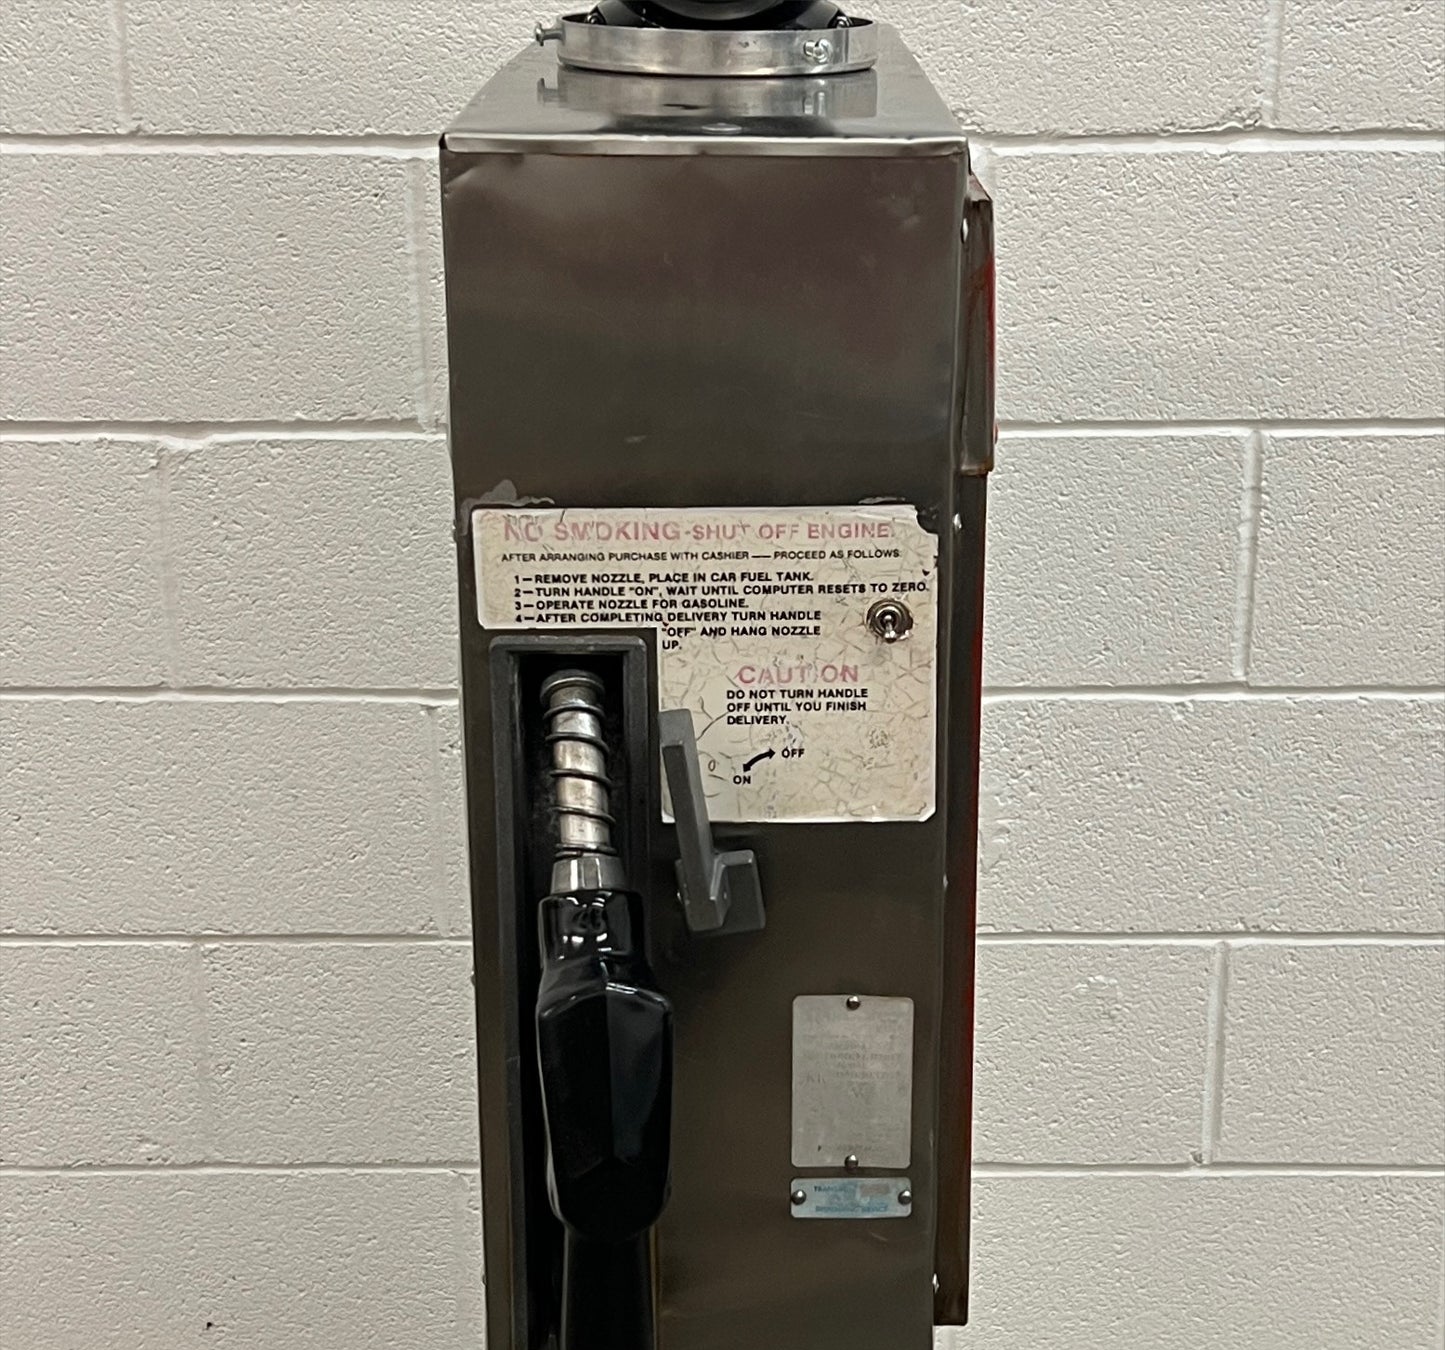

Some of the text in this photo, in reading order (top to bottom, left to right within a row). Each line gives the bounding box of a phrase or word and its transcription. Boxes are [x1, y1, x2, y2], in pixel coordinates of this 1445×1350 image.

[759, 523, 799, 539] OFF
[501, 553, 536, 562] AFTER
[539, 552, 605, 562] ARRANGING
[609, 551, 668, 561] PURCHASE
[670, 551, 698, 561] WITH
[702, 550, 750, 560] CASHIER
[773, 550, 826, 560] PROCEED
[830, 549, 844, 559] AS
[649, 572, 690, 583] PLACE
[693, 572, 707, 583] IN
[711, 571, 736, 582] CAR
[740, 571, 772, 582] FUEL
[776, 571, 815, 581] TANK.
[574, 586, 626, 597] HANDLE
[666, 586, 699, 596] WAIT
[702, 585, 739, 595] UNTIL
[743, 584, 814, 595] COMPUTER
[818, 583, 866, 594] RESETS
[870, 582, 888, 593] TO
[599, 599, 649, 609] NOZZLE
[652, 599, 678, 609] FOR
[682, 598, 750, 609] GASOLINE.
[580, 612, 664, 623] COMPLETING
[667, 612, 728, 622] DELIVERY
[731, 611, 767, 621] TURN
[770, 610, 822, 621] HANDLE
[661, 625, 821, 638] "OFF" AND HANG NOZZLE
[662, 640, 683, 650] UP.
[726, 688, 869, 699] DO NOT TURN HANDLE
[726, 701, 867, 712] OFF UNTIL YOU FINISH
[726, 715, 790, 725] DELIVERY.
[781, 748, 805, 758] OFF
[733, 775, 751, 785] ON
